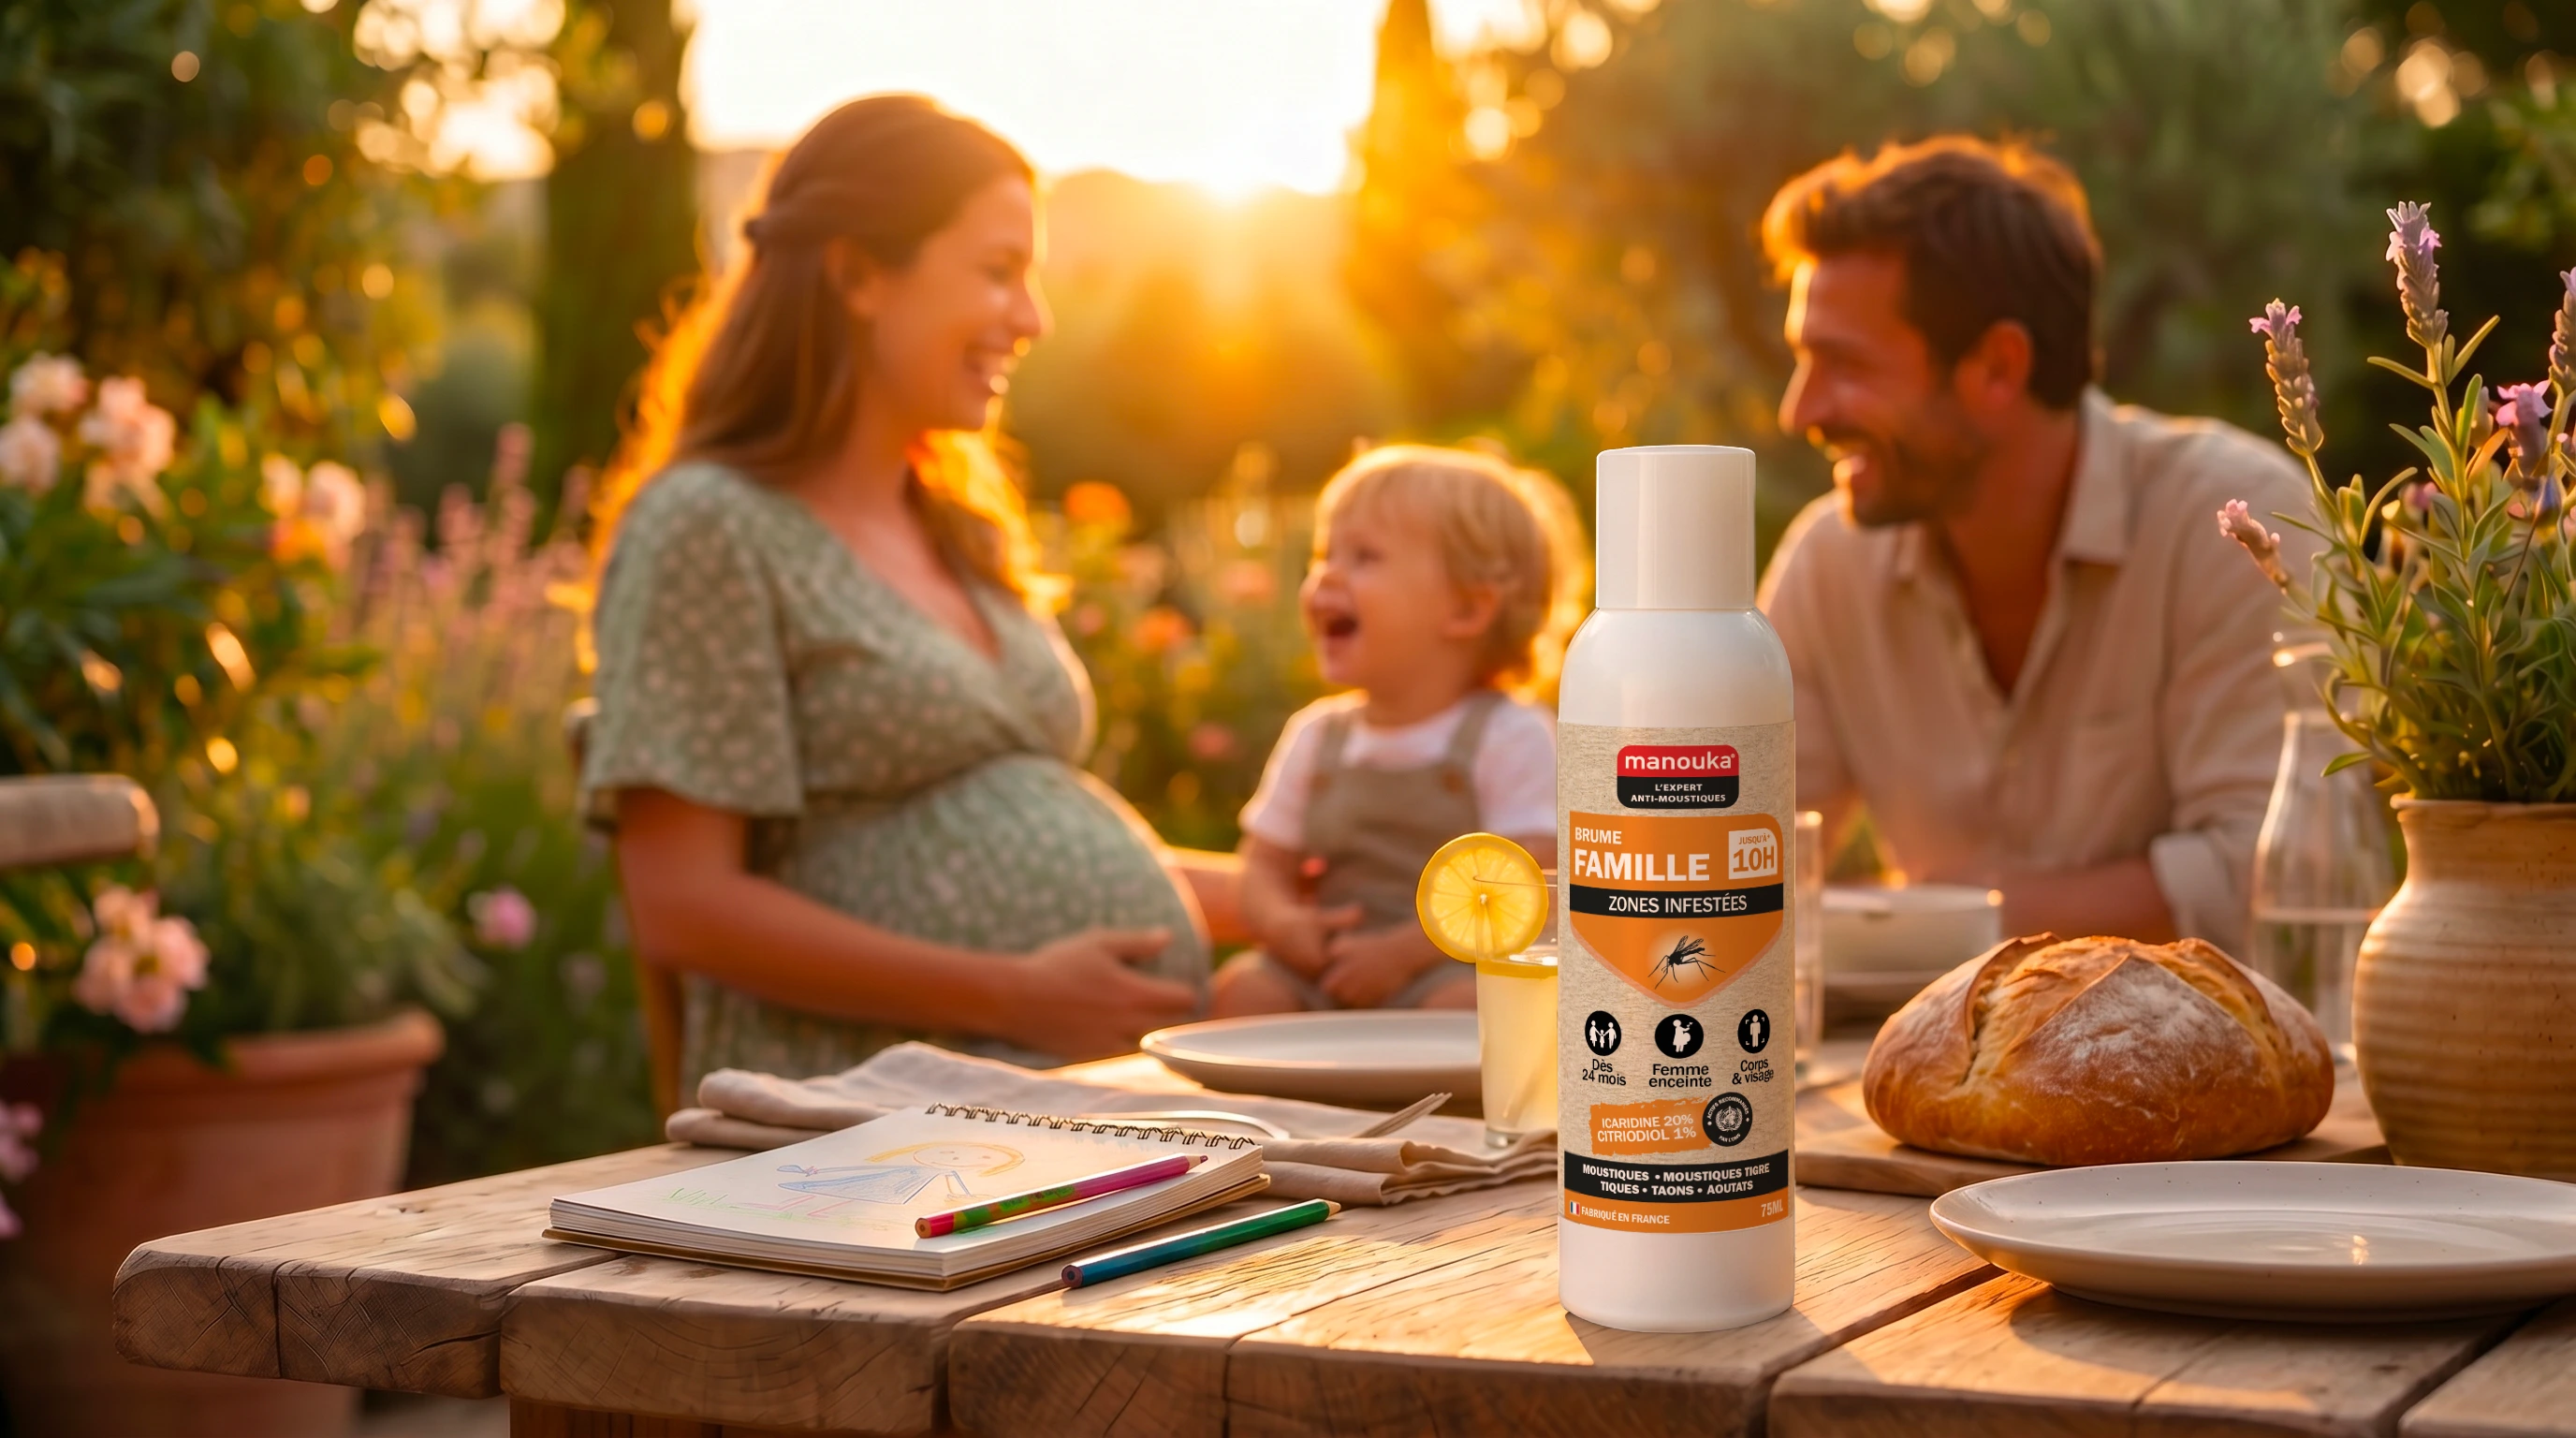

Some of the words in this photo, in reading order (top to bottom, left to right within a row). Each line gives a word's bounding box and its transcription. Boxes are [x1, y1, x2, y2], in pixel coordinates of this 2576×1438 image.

[1631, 794, 1726, 803] ANTI-MOUSTIQUES
[1574, 827, 1622, 844] BRUME
[1574, 847, 1710, 882] FAMILLE
[1733, 844, 1775, 873] 10H
[1608, 895, 1660, 913] ZONES
[1665, 893, 1748, 914] INFESTÉES
[1592, 1058, 1613, 1073] Dès
[1652, 1064, 1709, 1076] Femme
[1740, 1059, 1769, 1072] Corps
[1582, 1068, 1595, 1081] 24
[1598, 1072, 1627, 1086] mois
[1648, 1075, 1712, 1088] enceinte
[1732, 1072, 1742, 1085] &
[1745, 1068, 1775, 1083] visage
[1602, 1116, 1661, 1129] ICARIDINE
[1663, 1114, 1693, 1127] 20%
[1597, 1129, 1670, 1142] CITRIODIOL
[1674, 1126, 1697, 1140] 1%
[1582, 1164, 1649, 1181] MOUSTIQUES
[1662, 1167, 1742, 1182] MOUSTIQUES
[1744, 1163, 1770, 1175] TIGRE
[1600, 1181, 1640, 1195] TIQUES
[1651, 1185, 1694, 1196] TAONS
[1706, 1181, 1754, 1196] AOUTATS
[1581, 1206, 1617, 1221] FABRIQUÉ
[1617, 1212, 1630, 1222] EN
[1632, 1213, 1670, 1225] FRANCE
[1761, 1199, 1784, 1218] 75ML
